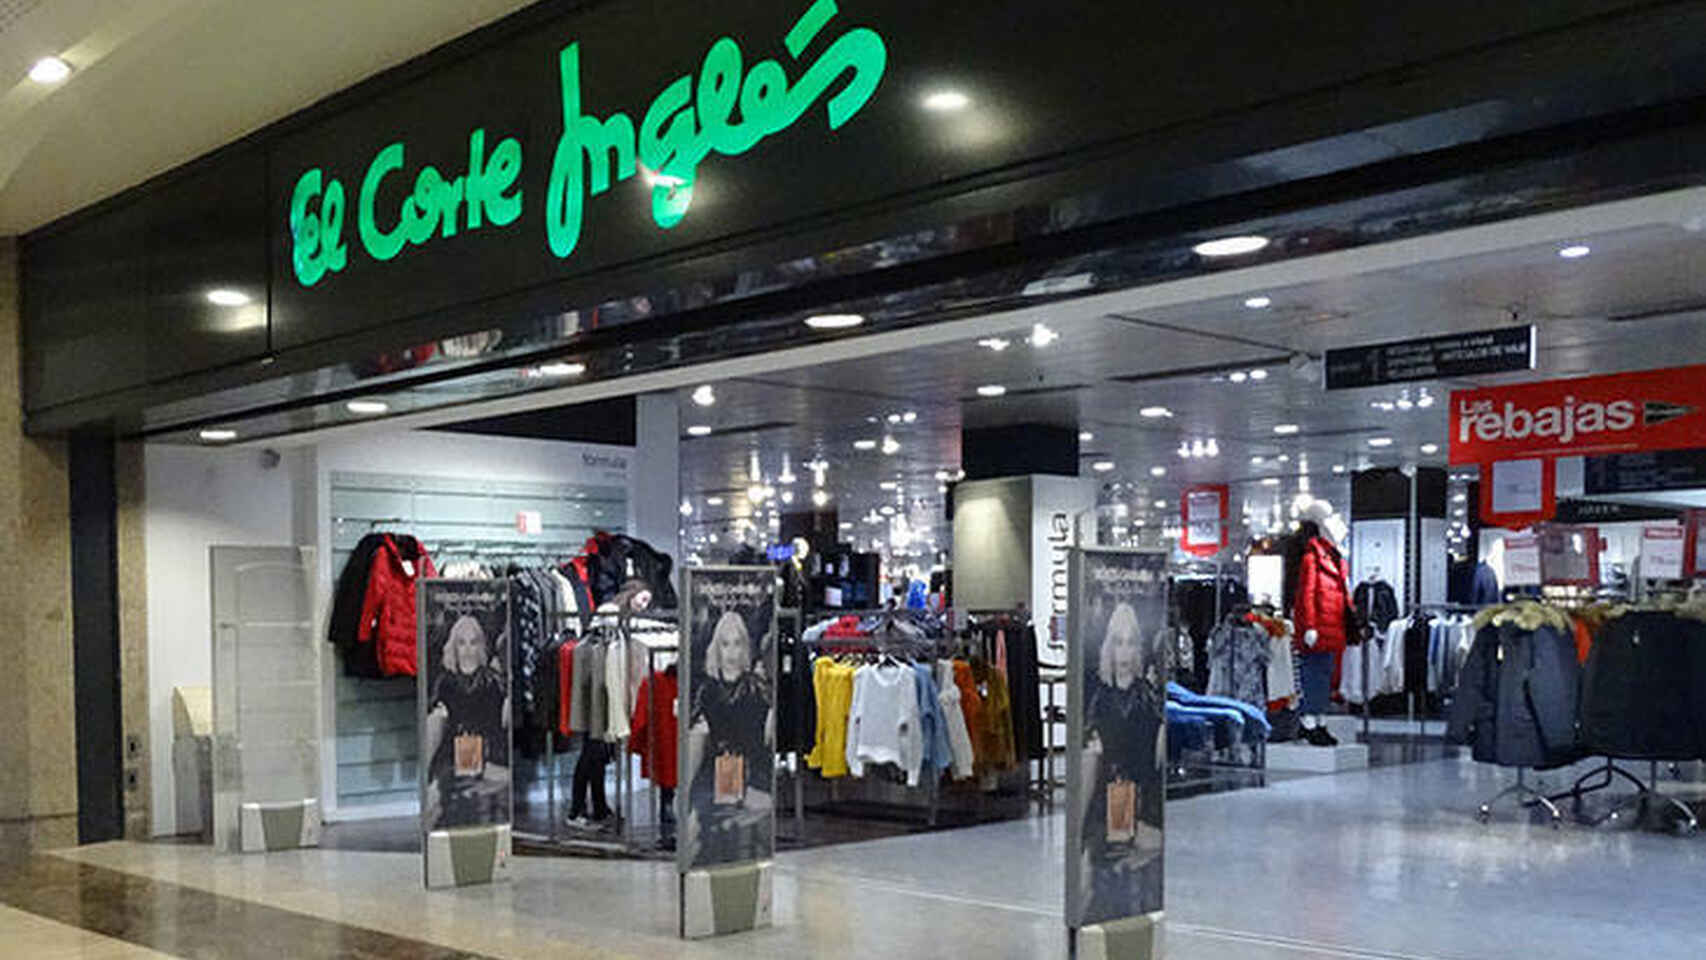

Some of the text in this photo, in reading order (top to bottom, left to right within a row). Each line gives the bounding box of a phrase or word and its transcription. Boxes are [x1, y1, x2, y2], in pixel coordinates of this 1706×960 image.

[291, 168, 346, 287] El
[358, 128, 522, 260] Corte
[1459, 395, 1635, 443] rebajas
